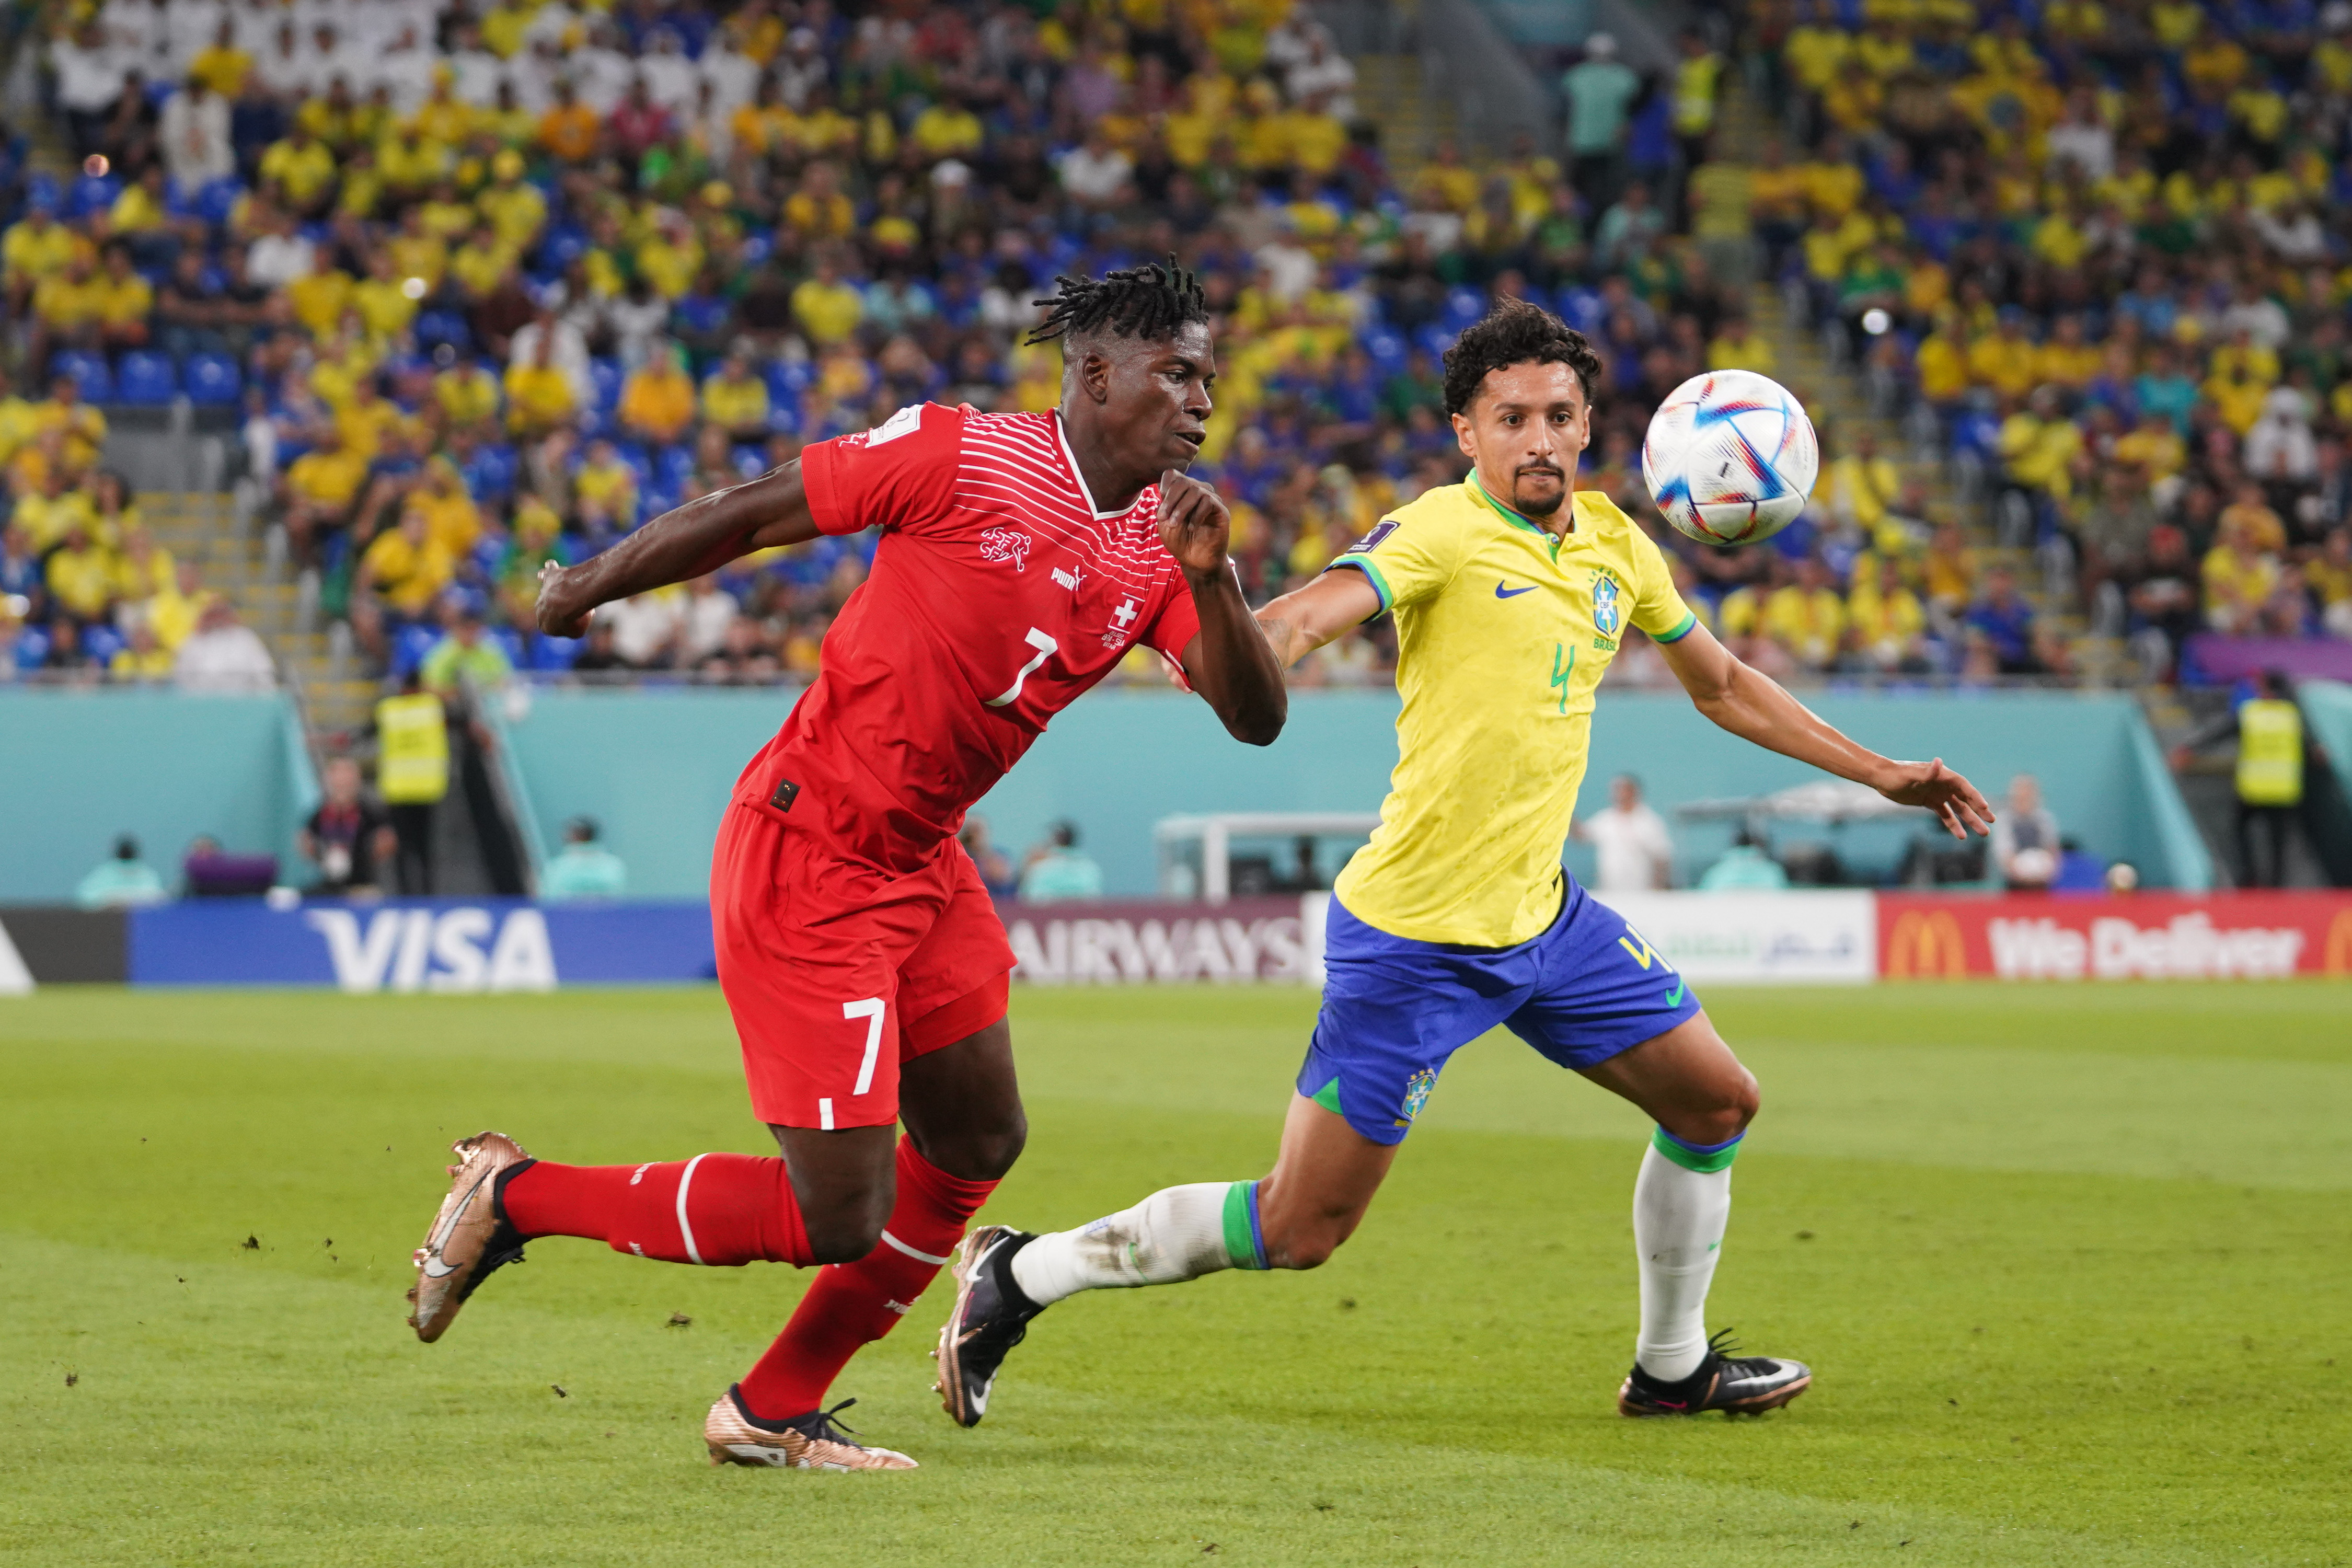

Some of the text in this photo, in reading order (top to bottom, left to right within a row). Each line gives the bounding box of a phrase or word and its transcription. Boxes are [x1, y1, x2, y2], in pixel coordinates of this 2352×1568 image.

[984, 626, 1058, 707] 7
[1551, 642, 1575, 714] 4
[308, 908, 558, 990] VISA
[1008, 917, 1305, 983] AIRWAYS
[1618, 922, 1673, 973] 4
[1988, 912, 2302, 979] We Deliver
[843, 997, 885, 1096] 7
